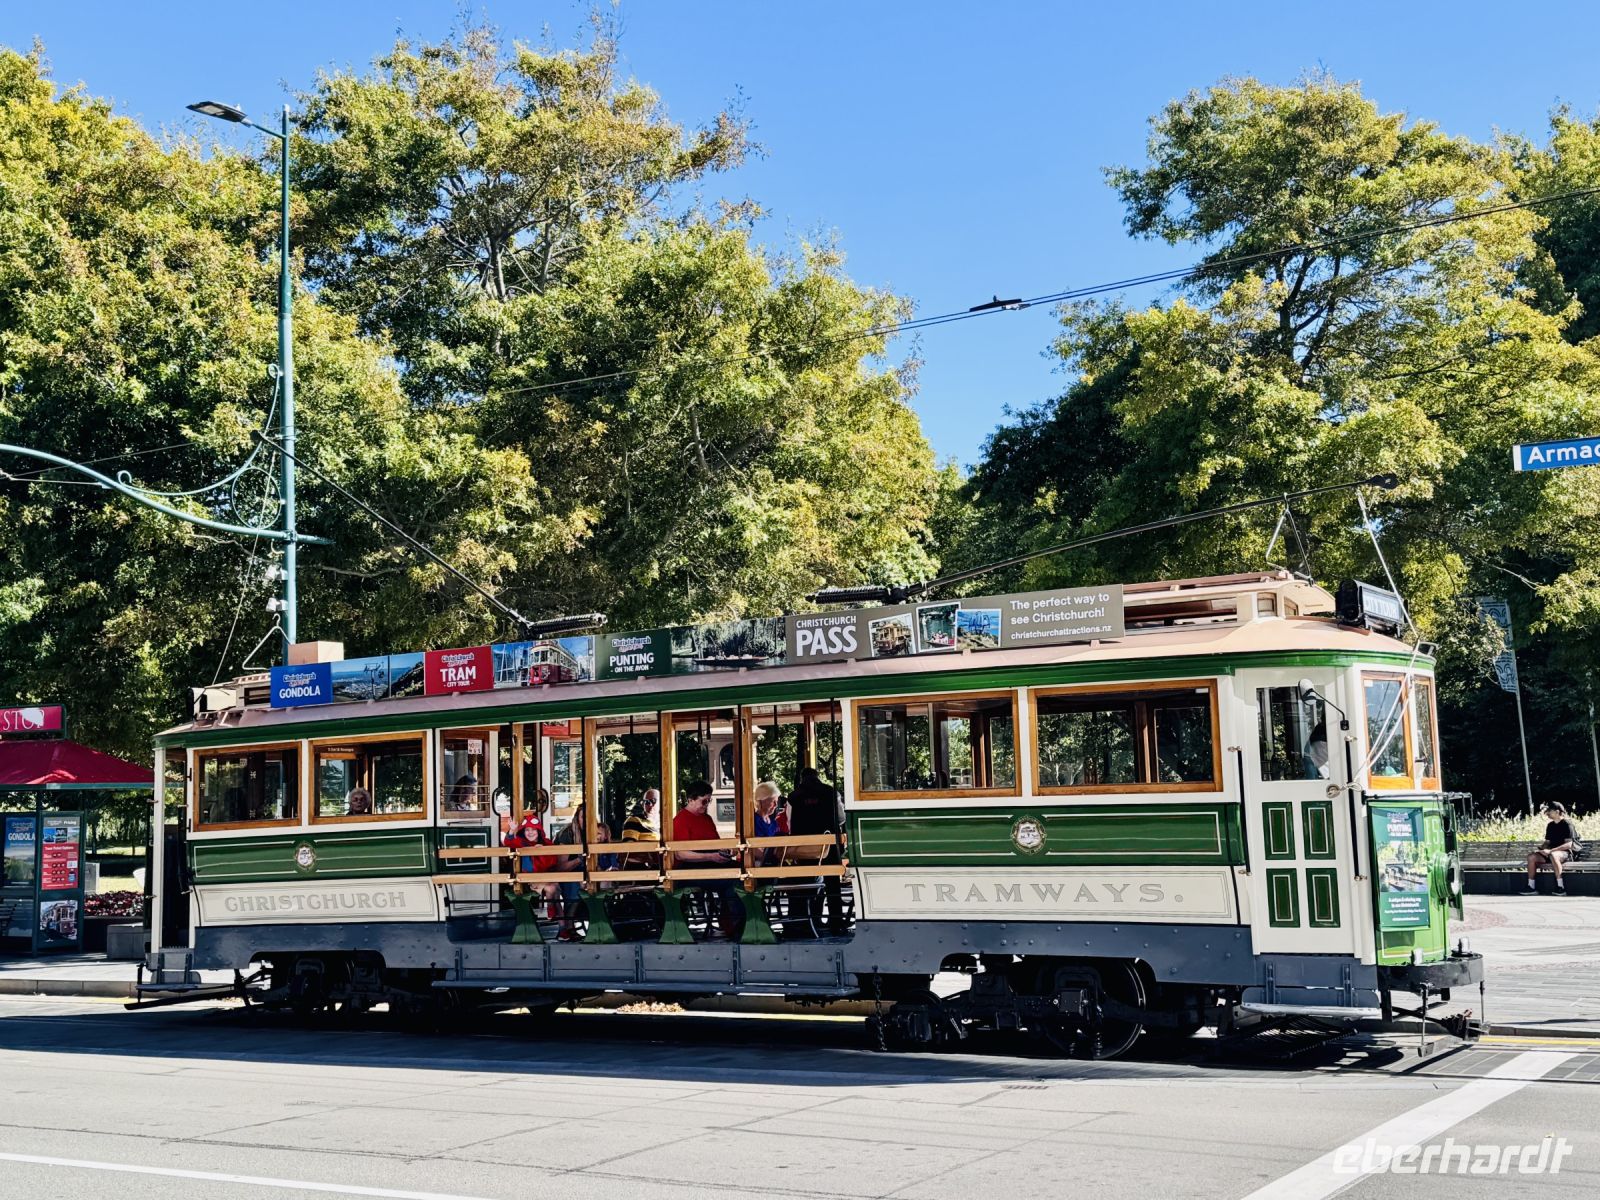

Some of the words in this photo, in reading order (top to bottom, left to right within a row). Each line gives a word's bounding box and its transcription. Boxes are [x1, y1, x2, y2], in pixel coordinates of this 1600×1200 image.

[1010, 600, 1030, 610] The
[1033, 597, 1071, 610] perfect
[1074, 594, 1096, 606] way
[1098, 592, 1110, 602] to
[796, 615, 857, 628] CHRISTCHURCH
[1010, 615, 1030, 625] see
[1032, 607, 1105, 624] Christchurch!
[1011, 624, 1112, 640] christchurchattractions.nz
[796, 625, 858, 657] PASS
[610, 652, 654, 667] PUNTING
[440, 666, 476, 682] TRAM
[279, 685, 321, 699] GONDOLA
[8, 832, 36, 841] GONDOLA
[904, 883, 1184, 902] TRAMWAYS.
[225, 891, 407, 912] CHRISTCHURCH
